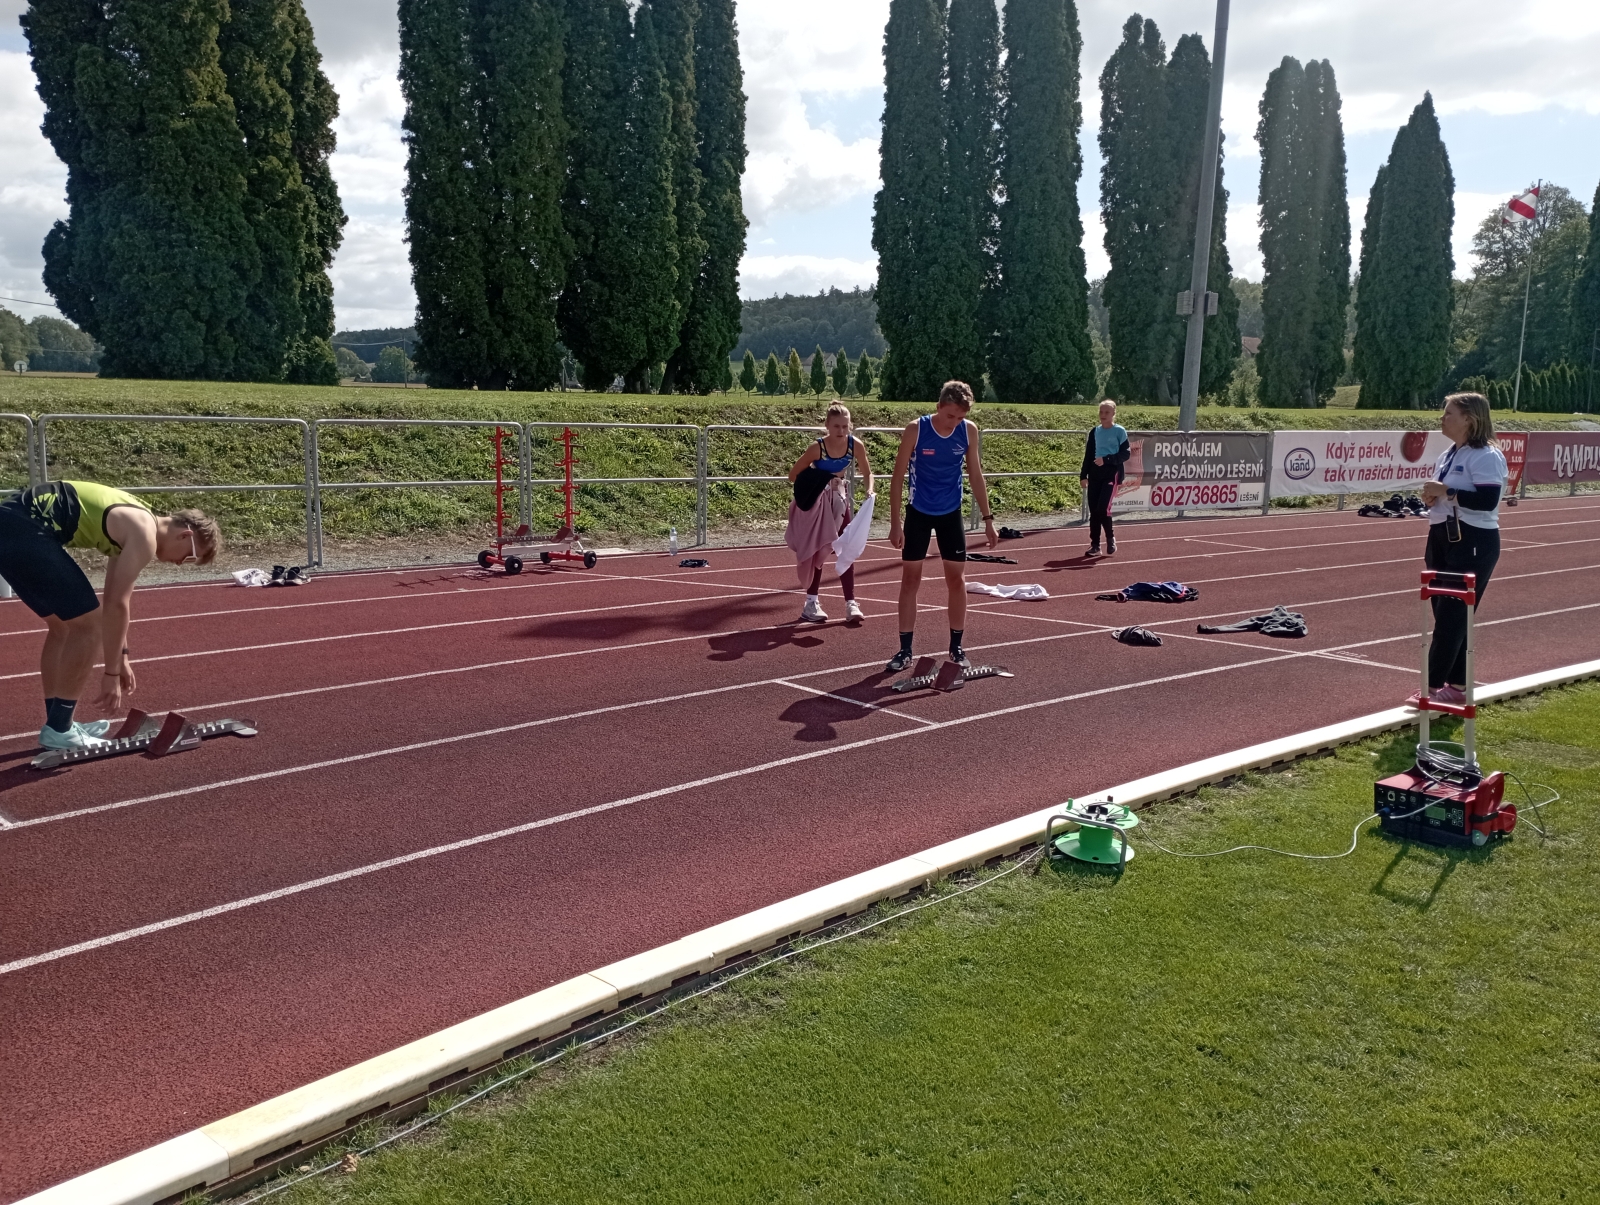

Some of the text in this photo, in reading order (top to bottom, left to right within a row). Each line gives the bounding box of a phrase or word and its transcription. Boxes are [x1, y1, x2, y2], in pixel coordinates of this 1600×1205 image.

[1153, 438, 1222, 458] PRONÁJEM
[1325, 442, 1394, 463] Když párek,
[1513, 439, 1525, 453] VM
[1154, 459, 1264, 480] FASÁDNÍHO LEŠENÍ
[1323, 464, 1346, 483] tak
[1348, 468, 1356, 482] v
[1357, 464, 1394, 481] našich
[1151, 484, 1238, 507] 602736865
[1239, 491, 1260, 502] LEŠENÍ
